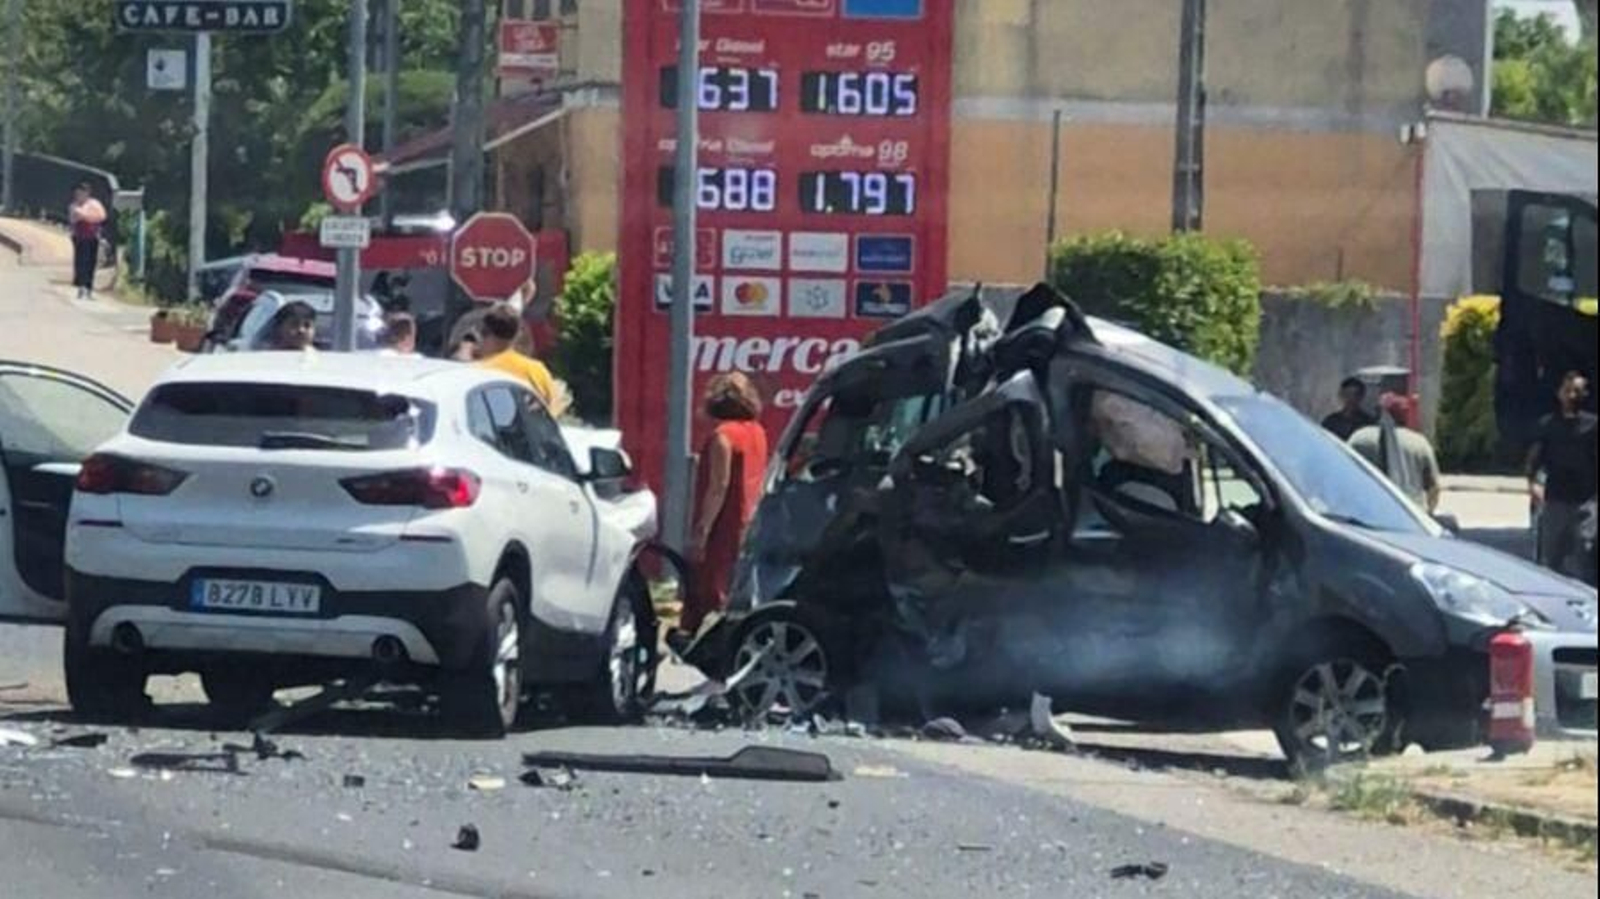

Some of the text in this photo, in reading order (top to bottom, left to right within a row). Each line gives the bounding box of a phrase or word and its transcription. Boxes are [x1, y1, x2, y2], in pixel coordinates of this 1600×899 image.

[123, 4, 280, 26] CAFE-BAR
[866, 41, 895, 61] 95
[697, 67, 778, 110] 637
[818, 72, 916, 115] 1.605
[695, 167, 776, 211] 688
[815, 171, 915, 214] 1.797
[460, 246, 526, 268] STOP
[270, 585, 314, 608] LYV
